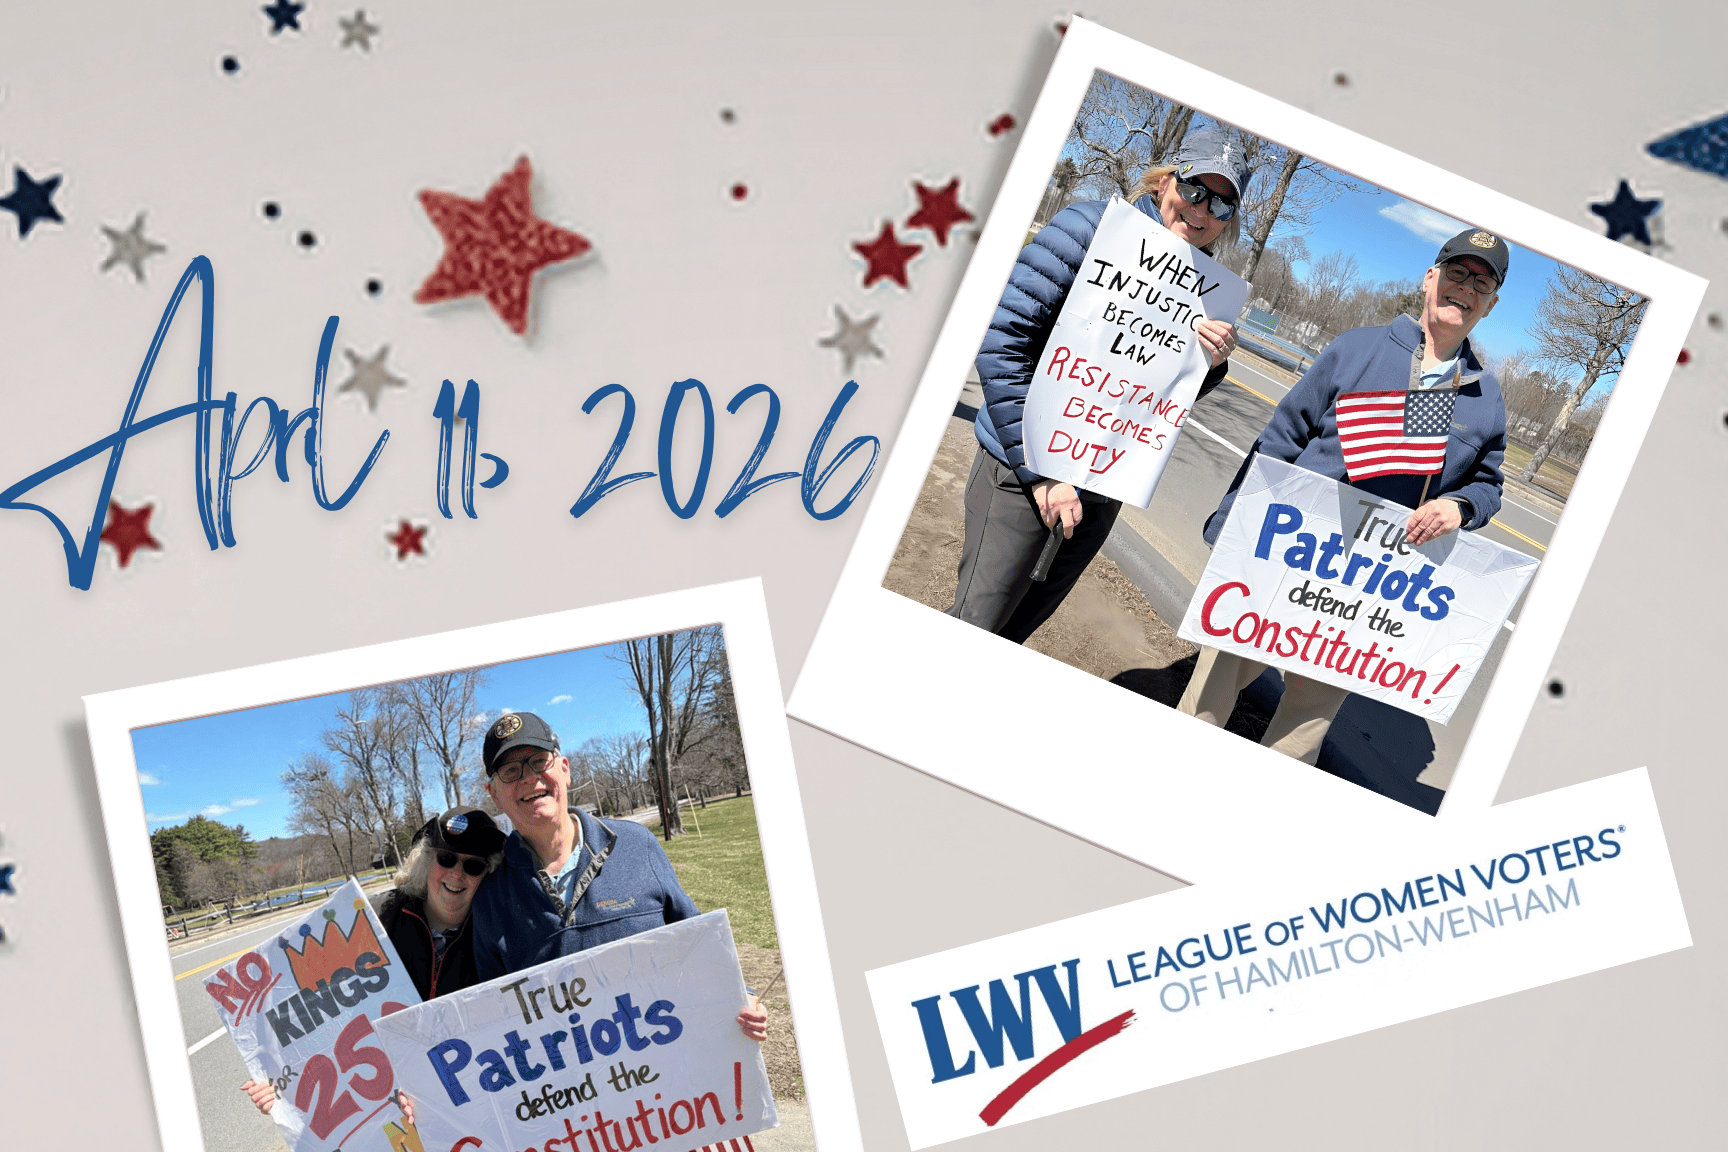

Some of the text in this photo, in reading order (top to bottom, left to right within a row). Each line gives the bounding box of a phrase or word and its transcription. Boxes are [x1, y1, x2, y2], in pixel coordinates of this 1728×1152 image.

[1087, 258, 1204, 333] INJUSTIC
[1139, 238, 1220, 297] WHEN
[1102, 302, 1186, 354] BECOMES
[1110, 332, 1156, 366] LAW
[1047, 346, 1191, 428] RESISTANCE
[1047, 430, 1126, 474] DUTY
[1063, 397, 1168, 451] BECOMES
[1353, 499, 1413, 556] True
[1254, 503, 1456, 621] Patriots
[1288, 580, 1405, 638] defend the
[1200, 581, 1461, 705] Constitution!
[205, 951, 272, 1015] NO
[265, 951, 390, 1048] KINGS
[500, 975, 592, 1025] True
[427, 993, 683, 1107] Patriots
[516, 1062, 660, 1122] defend the
